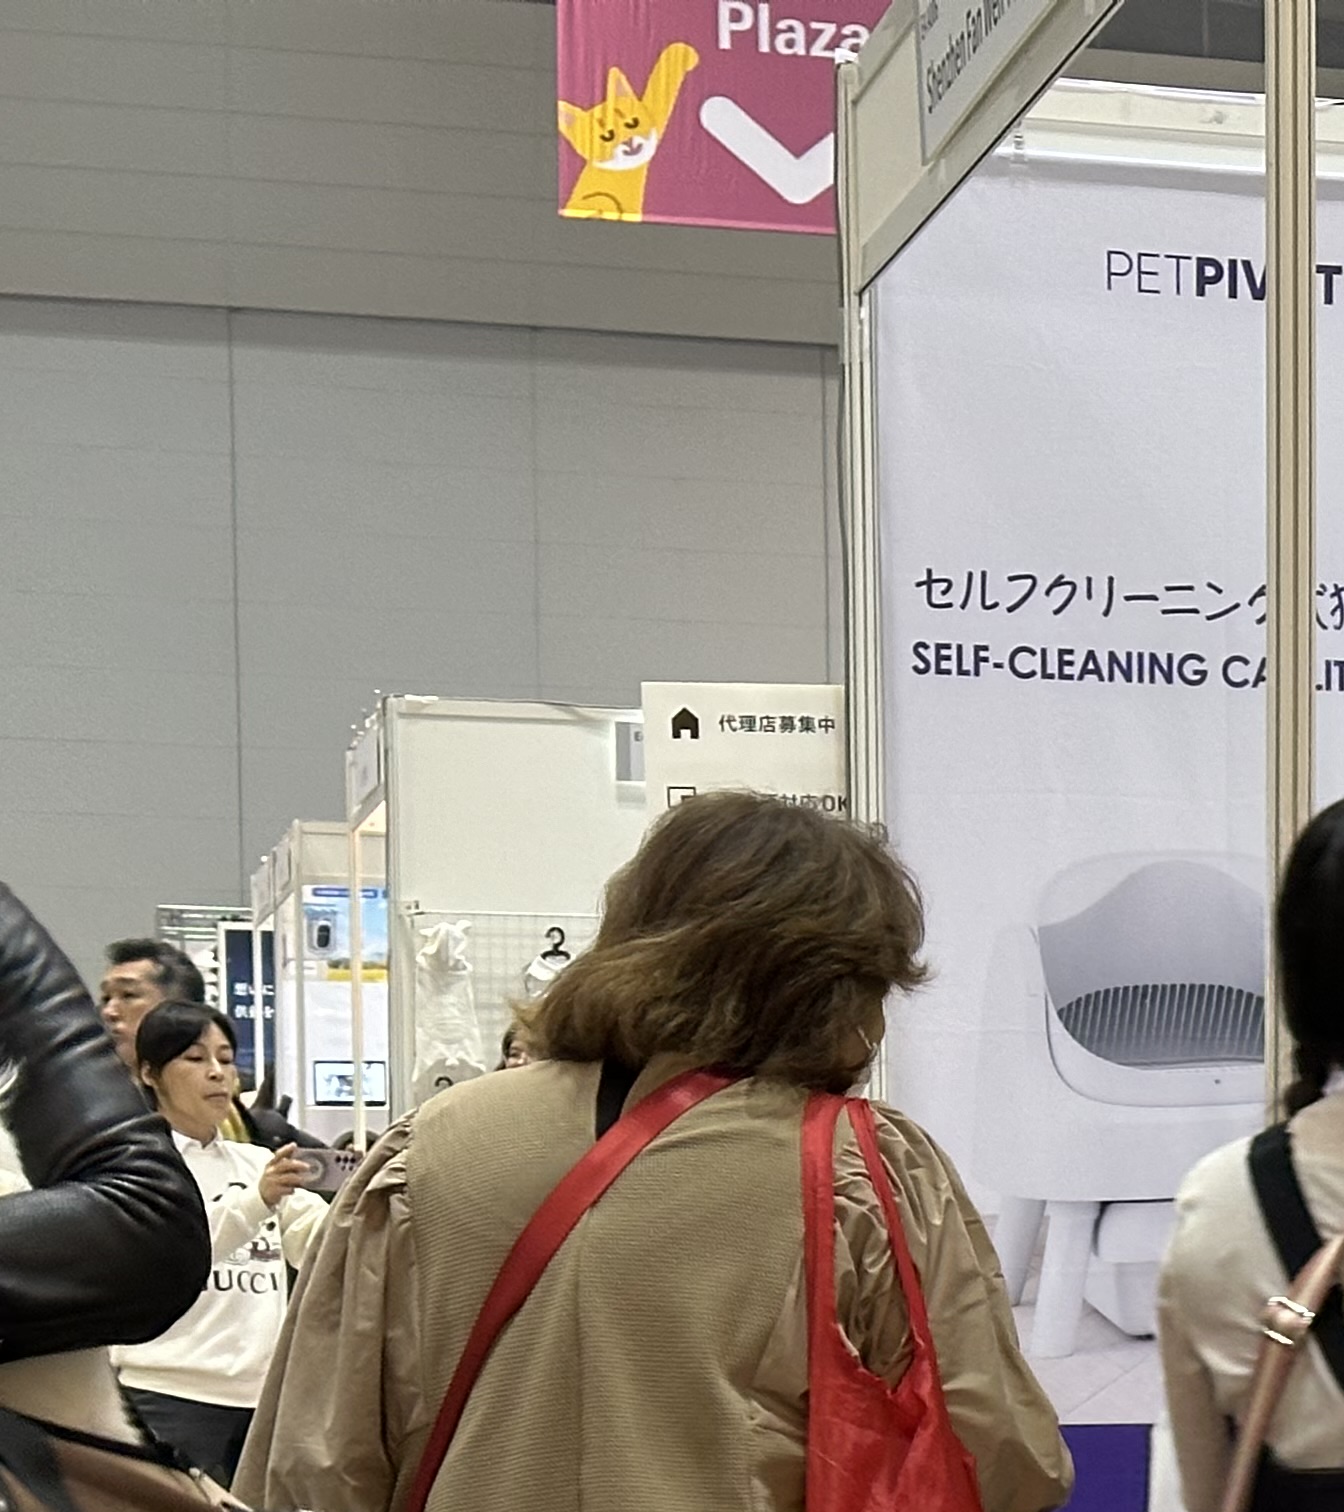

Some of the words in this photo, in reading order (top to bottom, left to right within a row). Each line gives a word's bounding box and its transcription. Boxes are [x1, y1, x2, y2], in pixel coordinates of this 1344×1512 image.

[717, 0, 869, 58] Plaza
[1104, 248, 1343, 308] PETPIVT
[911, 641, 1207, 689] SELF-CLEANING
[1221, 654, 1268, 690] CA
[718, 714, 836, 735] 代理店募集中
